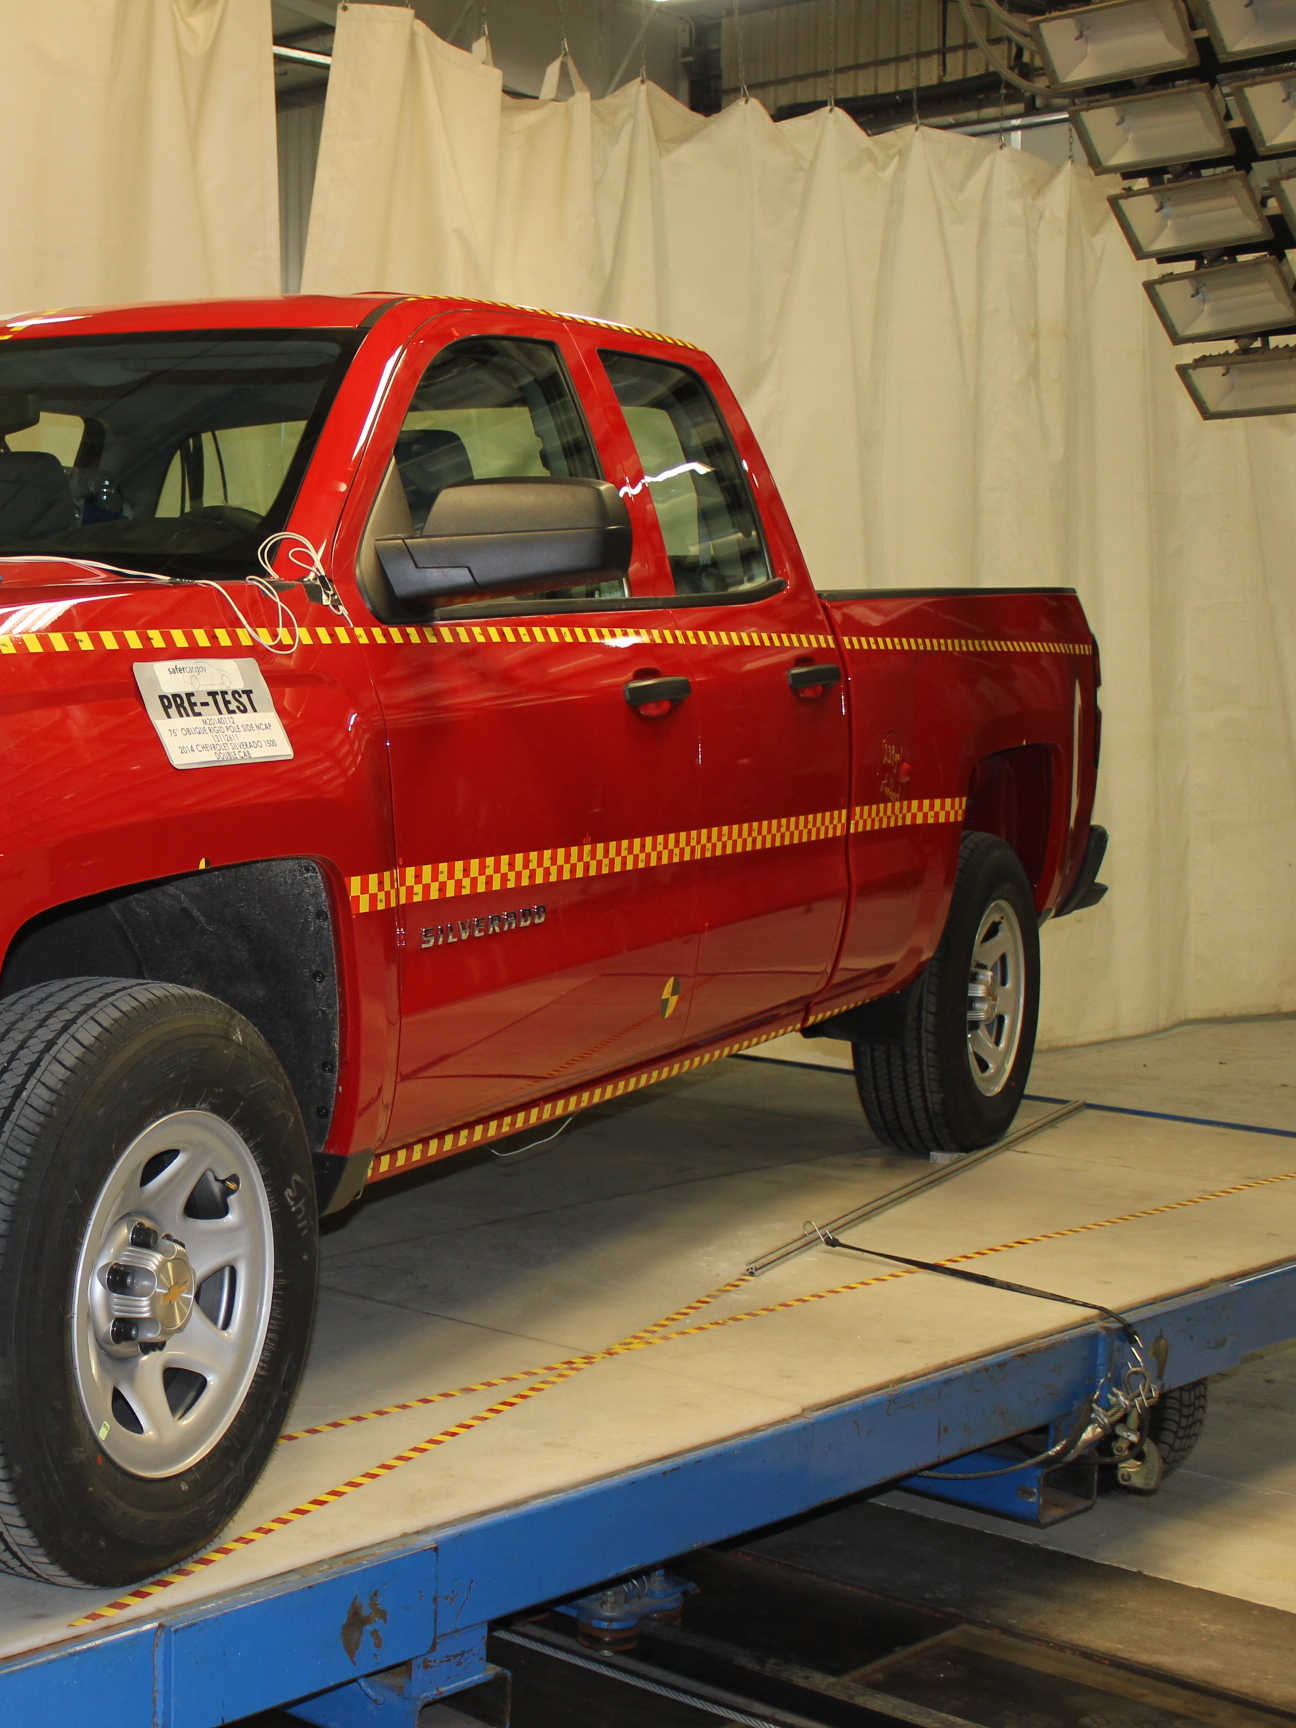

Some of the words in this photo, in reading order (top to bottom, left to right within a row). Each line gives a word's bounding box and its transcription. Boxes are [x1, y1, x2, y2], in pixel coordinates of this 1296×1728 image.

[168, 664, 206, 676] safercar.gov
[158, 690, 258, 719] PRE-TEST
[202, 717, 236, 725] M20140112
[181, 726, 208, 736] OBLIQUE
[208, 726, 225, 734] RIGID
[226, 724, 241, 734] POLE
[242, 723, 255, 732] SIDE
[256, 722, 272, 731] NCAP
[212, 734, 240, 742] 13112611
[178, 746, 195, 754] 2014
[196, 743, 230, 752] CHEVROLET
[230, 740, 263, 750] SILVERADO
[264, 739, 278, 748] 1500
[214, 751, 238, 760] DOUBLE
[238, 750, 252, 758] CAB
[420, 904, 546, 948] SILVERADO
